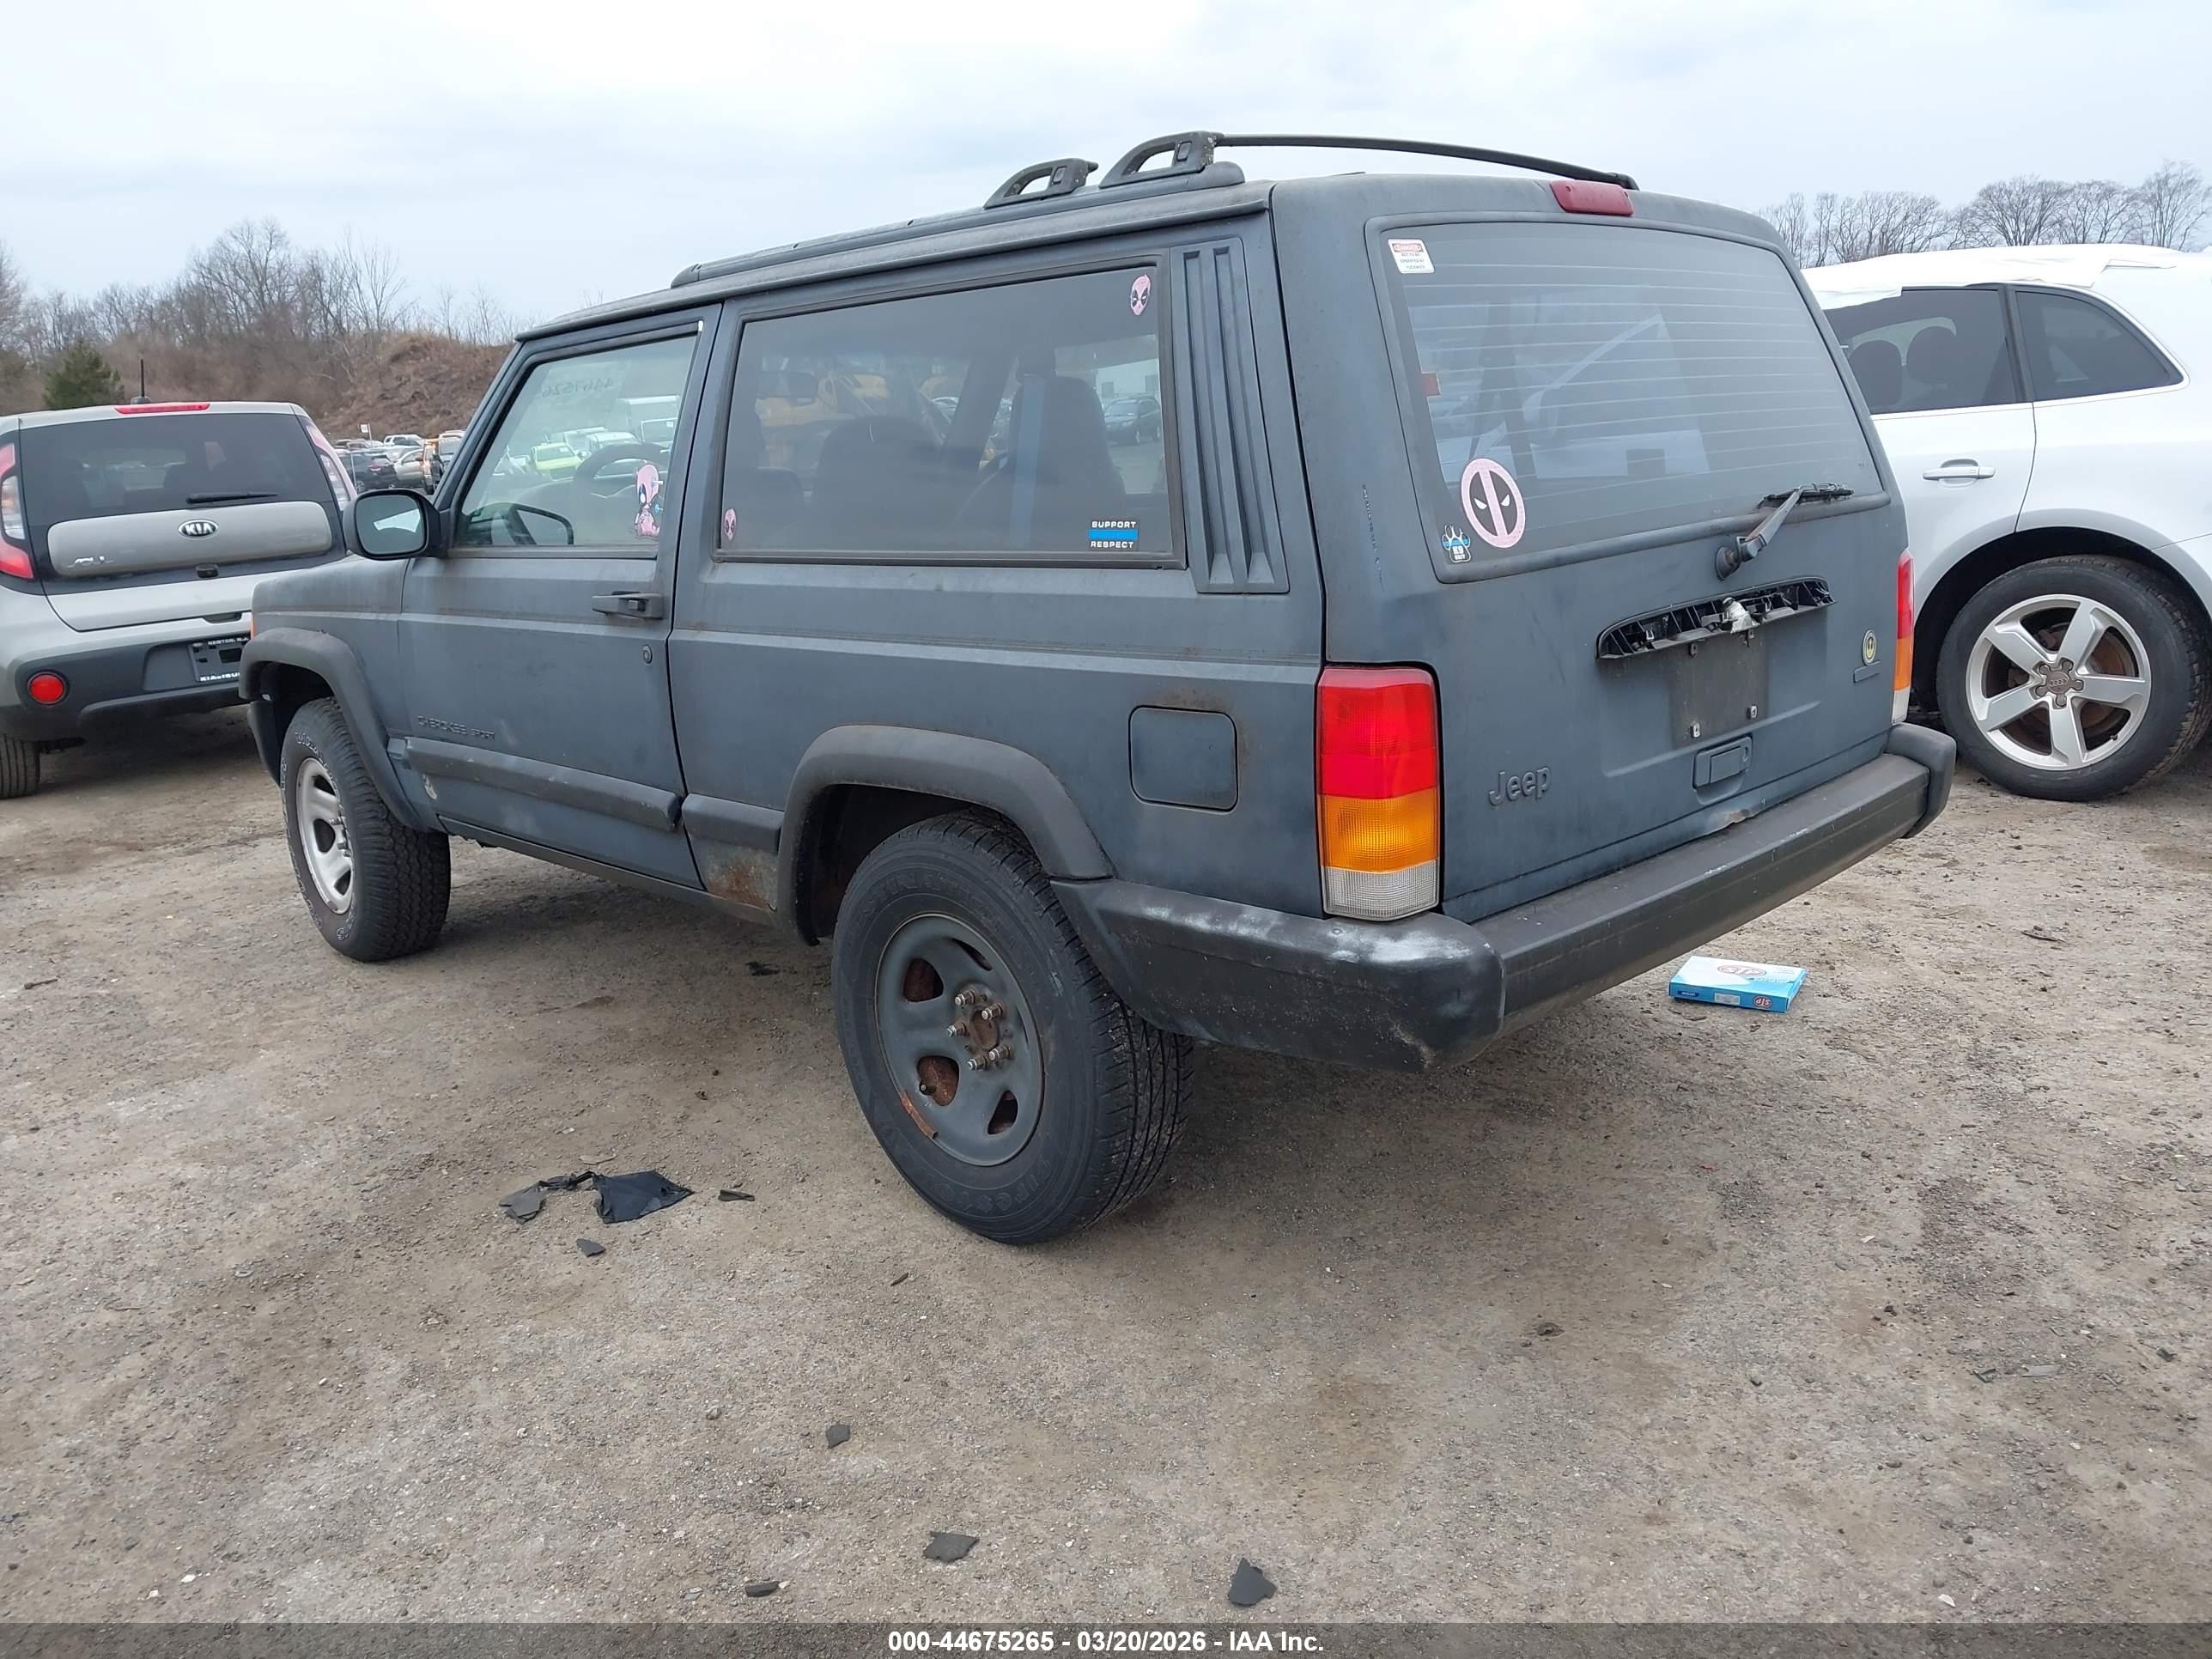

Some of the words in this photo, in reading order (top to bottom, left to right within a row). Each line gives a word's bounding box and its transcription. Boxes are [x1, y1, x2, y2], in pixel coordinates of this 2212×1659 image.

[185, 522, 214, 536] KIA
[1091, 520, 1137, 529] SUPPORT
[1091, 541, 1134, 550] RESPECT
[1487, 766, 1552, 806] Jeep
